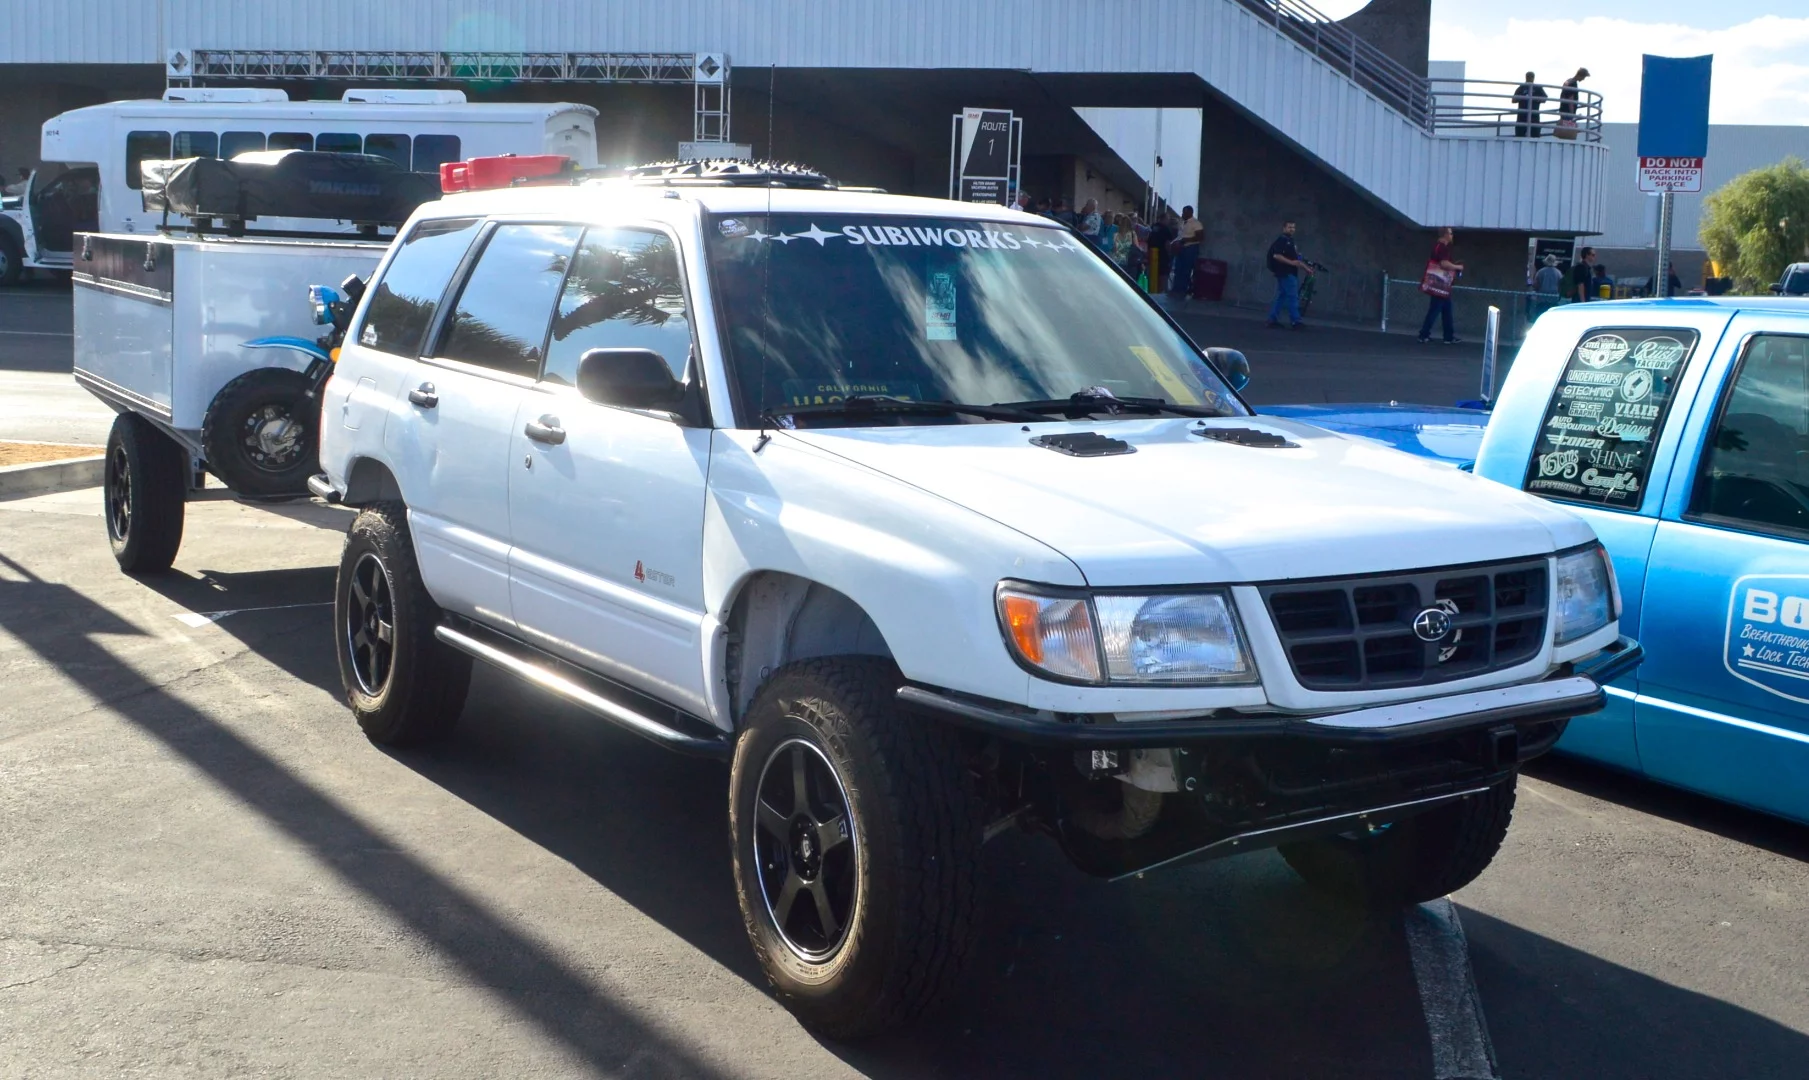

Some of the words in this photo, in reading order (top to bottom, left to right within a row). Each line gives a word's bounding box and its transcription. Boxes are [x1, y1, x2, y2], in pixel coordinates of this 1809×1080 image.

[981, 122, 1007, 131] ROUTE
[988, 138, 995, 156] 1
[1646, 157, 1667, 168] DO
[1670, 157, 1698, 168] NOT
[842, 225, 1021, 250] SUBIWORKS
[1636, 359, 1671, 368] FACTORY
[1569, 371, 1621, 384] UNDERWRAPS
[1615, 403, 1659, 417] VIAIR
[1588, 449, 1636, 469] SHINE
[1756, 646, 1783, 662] LOCK
